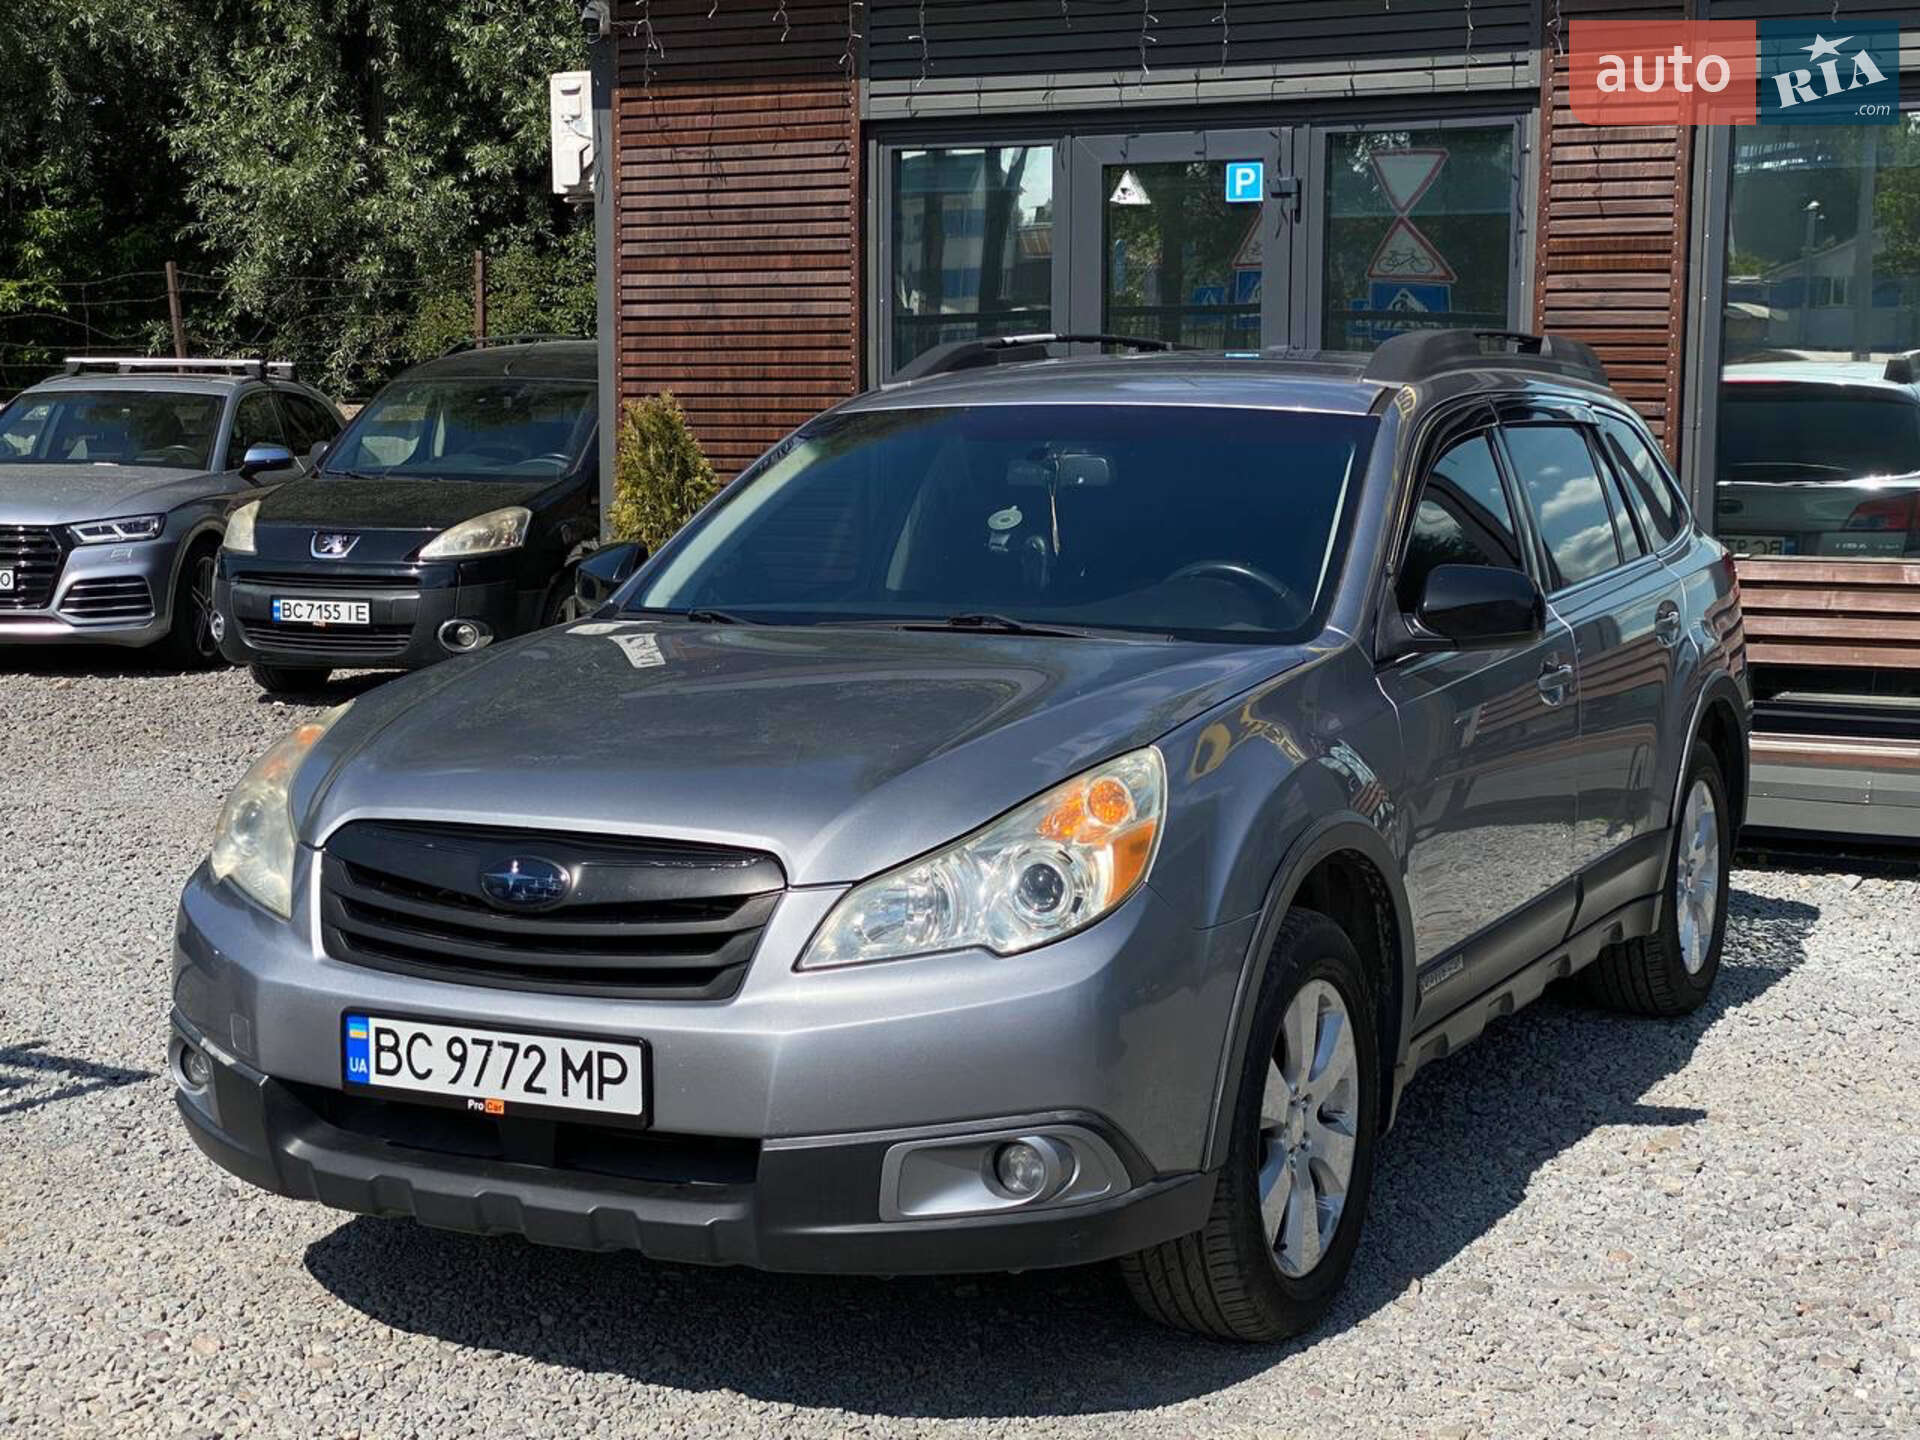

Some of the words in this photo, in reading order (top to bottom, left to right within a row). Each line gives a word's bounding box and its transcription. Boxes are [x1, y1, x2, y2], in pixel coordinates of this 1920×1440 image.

[1235, 168, 1256, 196] P
[282, 602, 303, 619] BC
[306, 603, 341, 620] 7155
[348, 605, 367, 622] IE
[350, 1057, 368, 1074] UA
[374, 1027, 433, 1080] BC
[446, 1035, 547, 1095] 9772
[561, 1047, 628, 1101] MP
